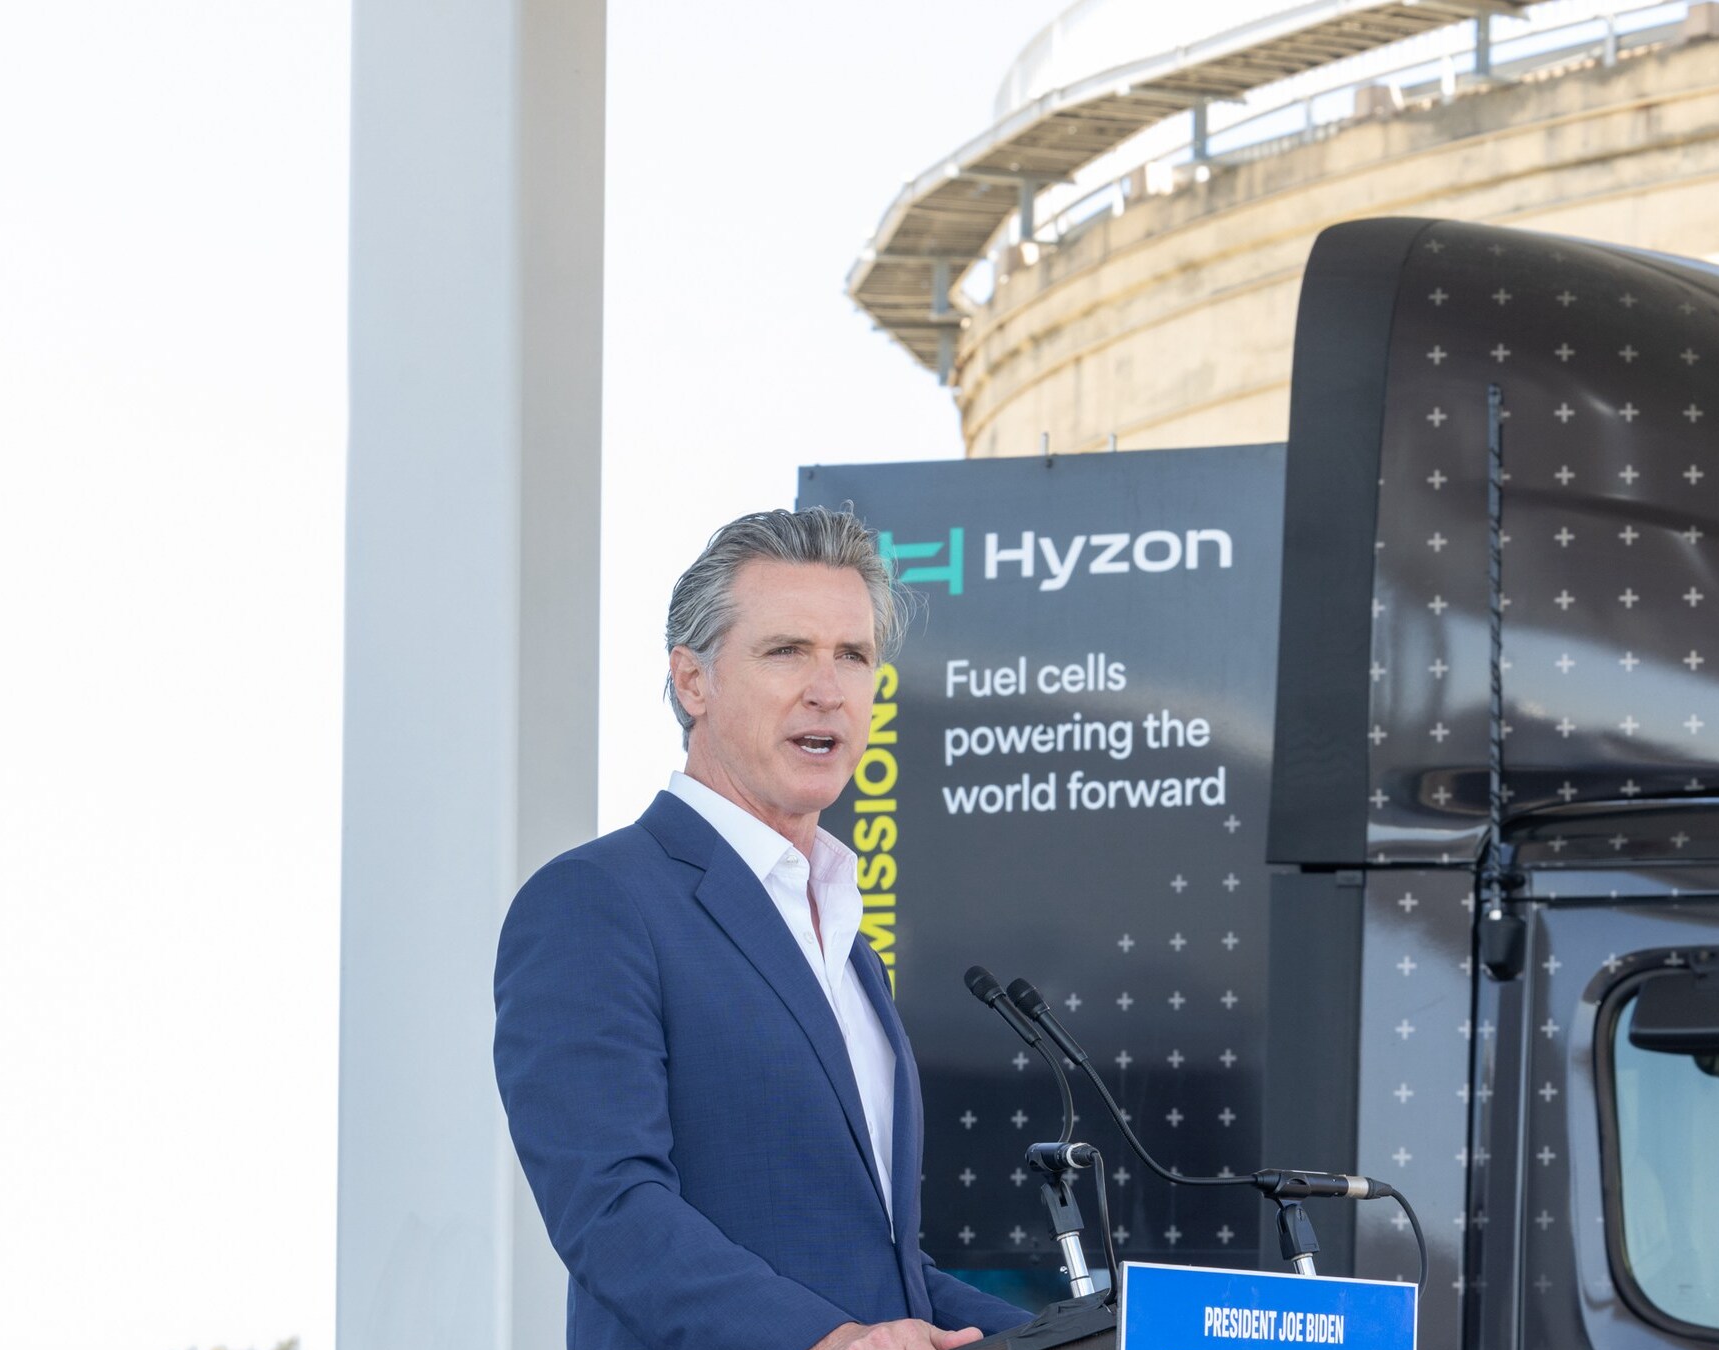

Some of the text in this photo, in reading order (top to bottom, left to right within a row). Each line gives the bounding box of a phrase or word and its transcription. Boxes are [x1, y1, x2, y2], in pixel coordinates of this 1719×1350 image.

[985, 528, 1233, 591] Hyzon
[946, 652, 1127, 698] Fuel cells
[945, 708, 1211, 766] powering the
[942, 766, 1226, 814] world forward
[853, 663, 899, 1000] MISSIONS
[1204, 1306, 1345, 1345] PRESIDENT JOE BIDEN
